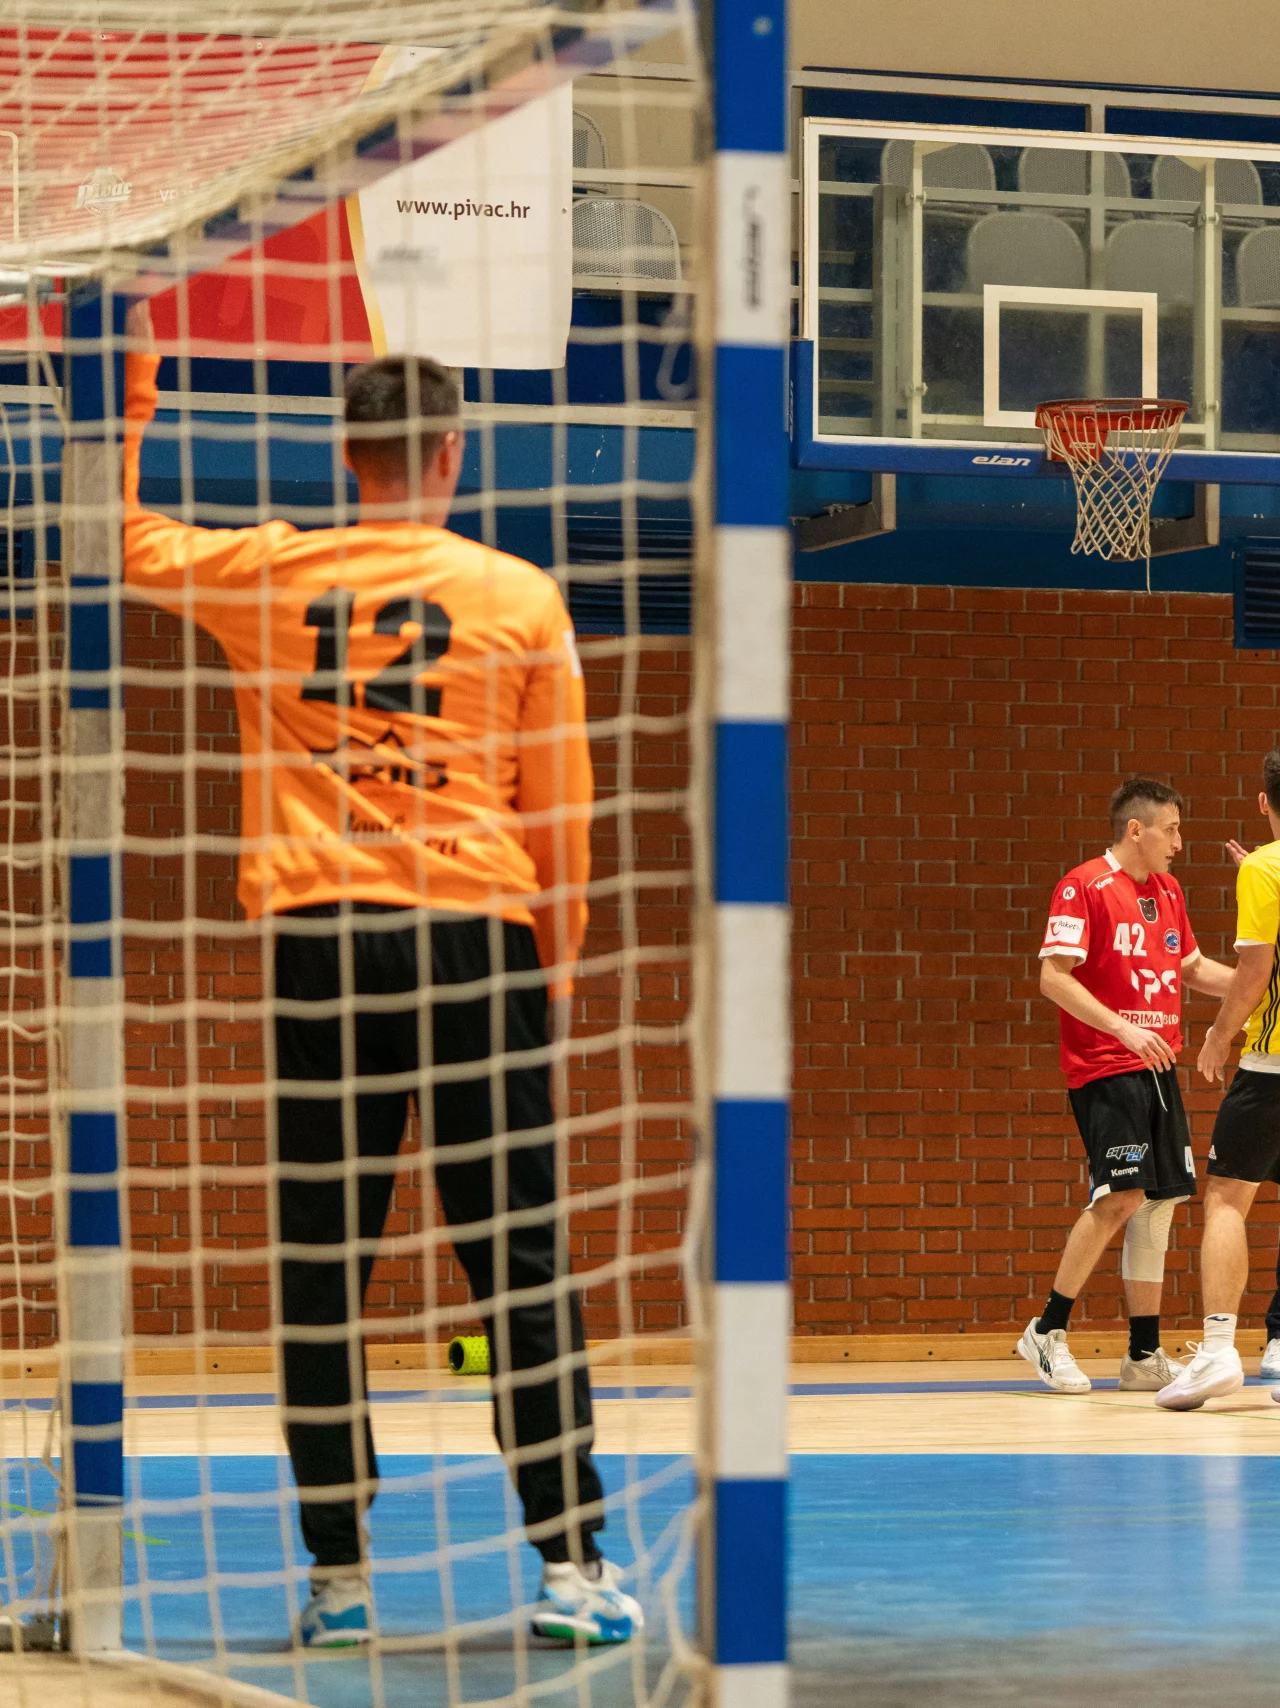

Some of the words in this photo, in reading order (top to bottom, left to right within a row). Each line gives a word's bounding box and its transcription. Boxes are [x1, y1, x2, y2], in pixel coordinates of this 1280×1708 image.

[396, 199, 530, 221] www.pivac.hr
[971, 455, 1032, 467] elan
[302, 585, 453, 717] 12
[1113, 923, 1147, 956] 42
[1111, 1166, 1139, 1177] Kempa
